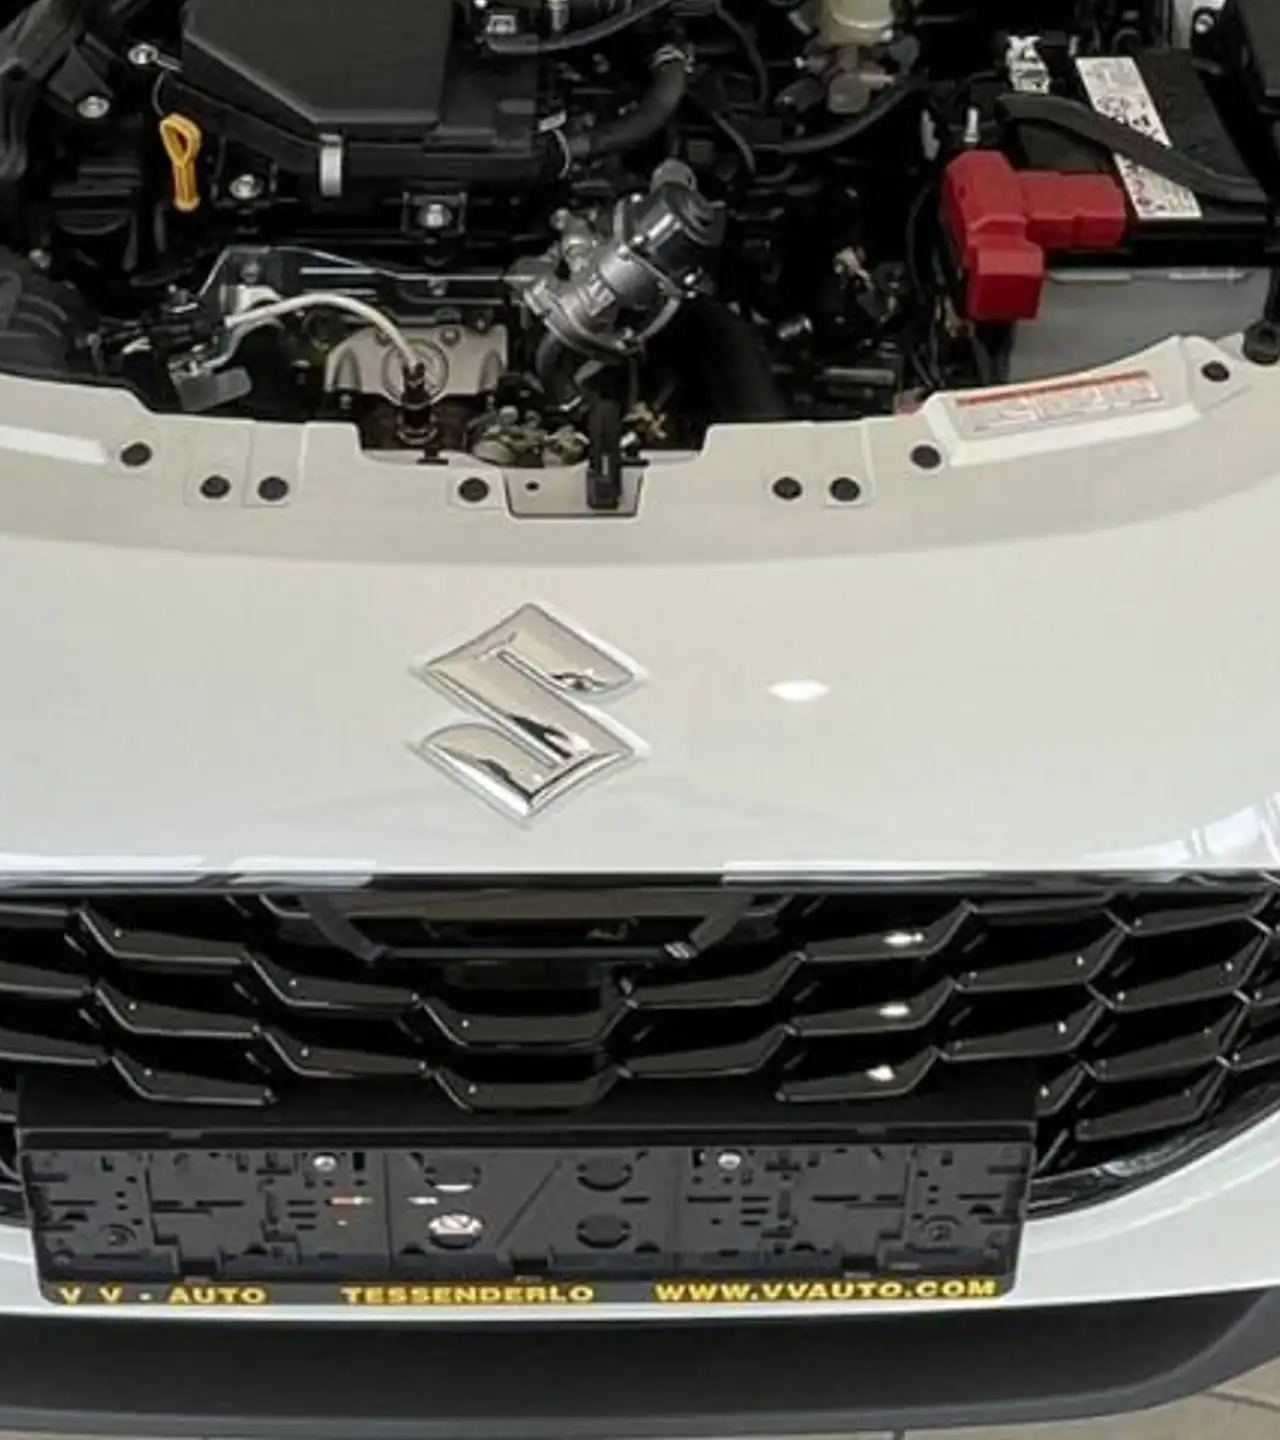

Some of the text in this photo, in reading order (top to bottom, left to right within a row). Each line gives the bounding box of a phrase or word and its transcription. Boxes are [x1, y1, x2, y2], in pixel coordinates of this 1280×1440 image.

[170, 1285, 268, 1304] AUTO
[340, 1284, 595, 1304] TESSENDERLO
[654, 1279, 997, 1302] WWW.VVAUTO.COM
